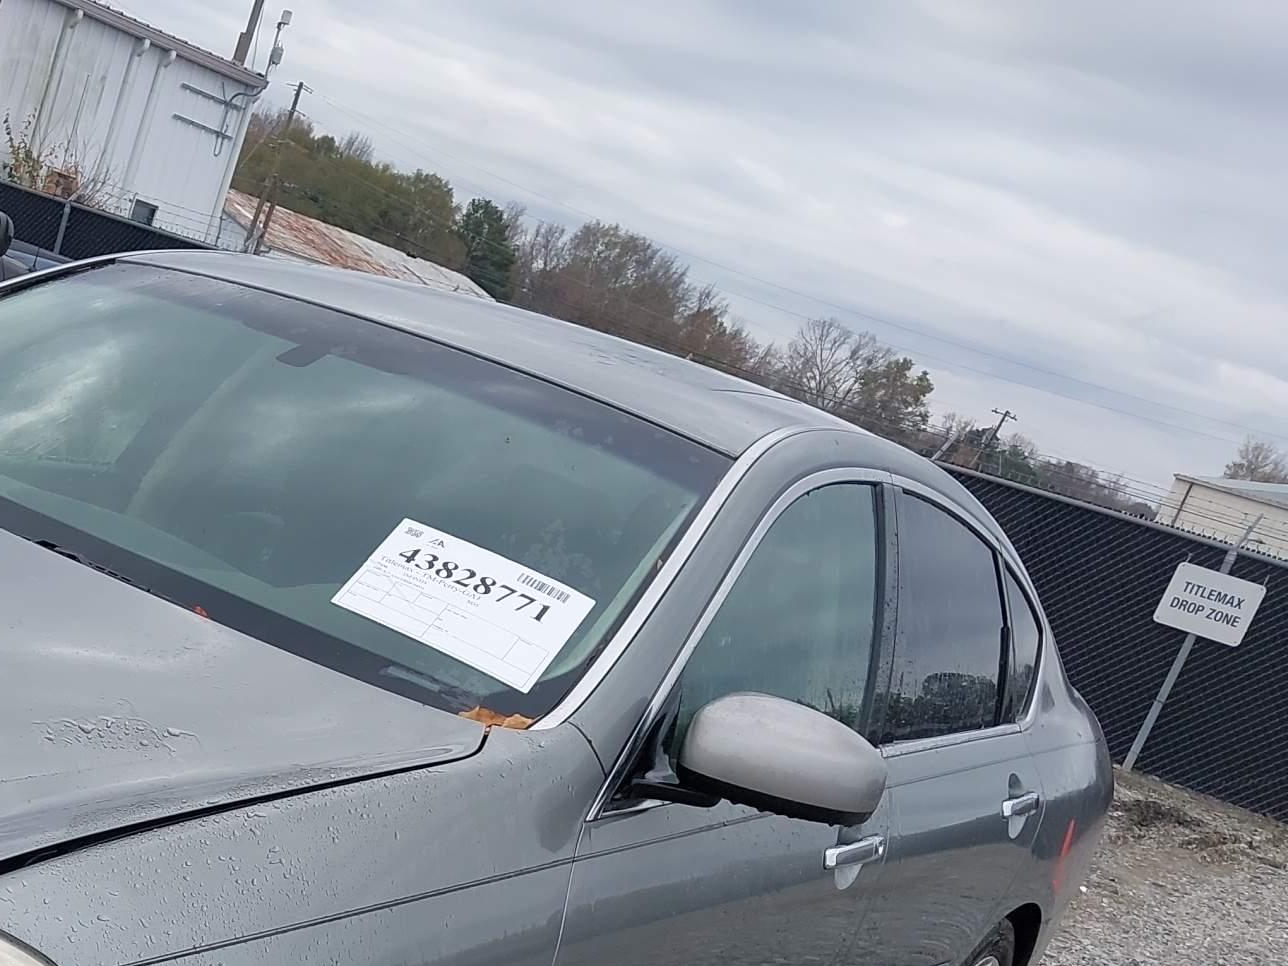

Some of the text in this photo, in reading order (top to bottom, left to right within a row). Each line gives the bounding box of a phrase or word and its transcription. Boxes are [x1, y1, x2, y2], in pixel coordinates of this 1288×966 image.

[397, 547, 553, 625] 43828771
[1183, 581, 1245, 610] TITLEMAX
[1170, 597, 1241, 628] DROP ZONE
